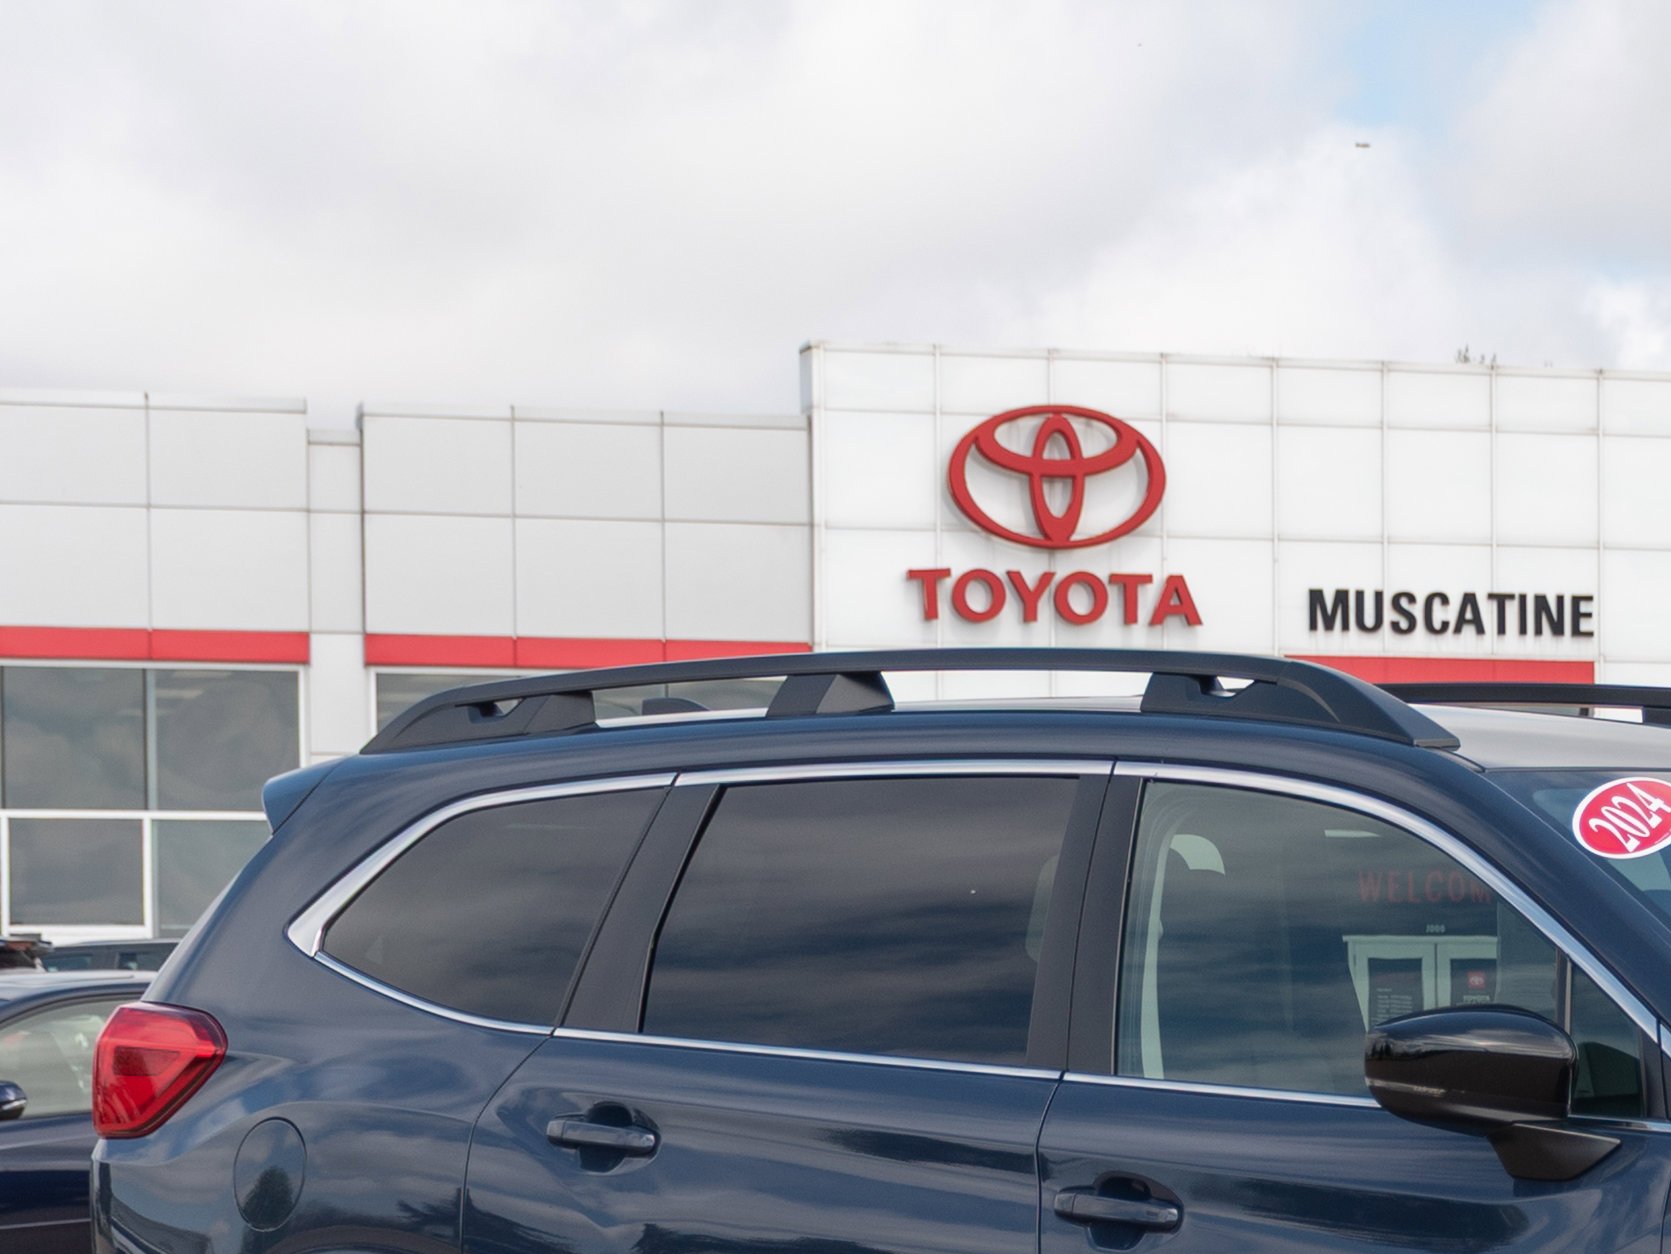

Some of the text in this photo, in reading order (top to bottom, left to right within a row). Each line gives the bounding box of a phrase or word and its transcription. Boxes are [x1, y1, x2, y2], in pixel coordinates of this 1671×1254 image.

[907, 568, 1203, 627] TOYOTA
[1308, 588, 1595, 638] MUSCATINE
[1359, 868, 1493, 904] WELCOM
